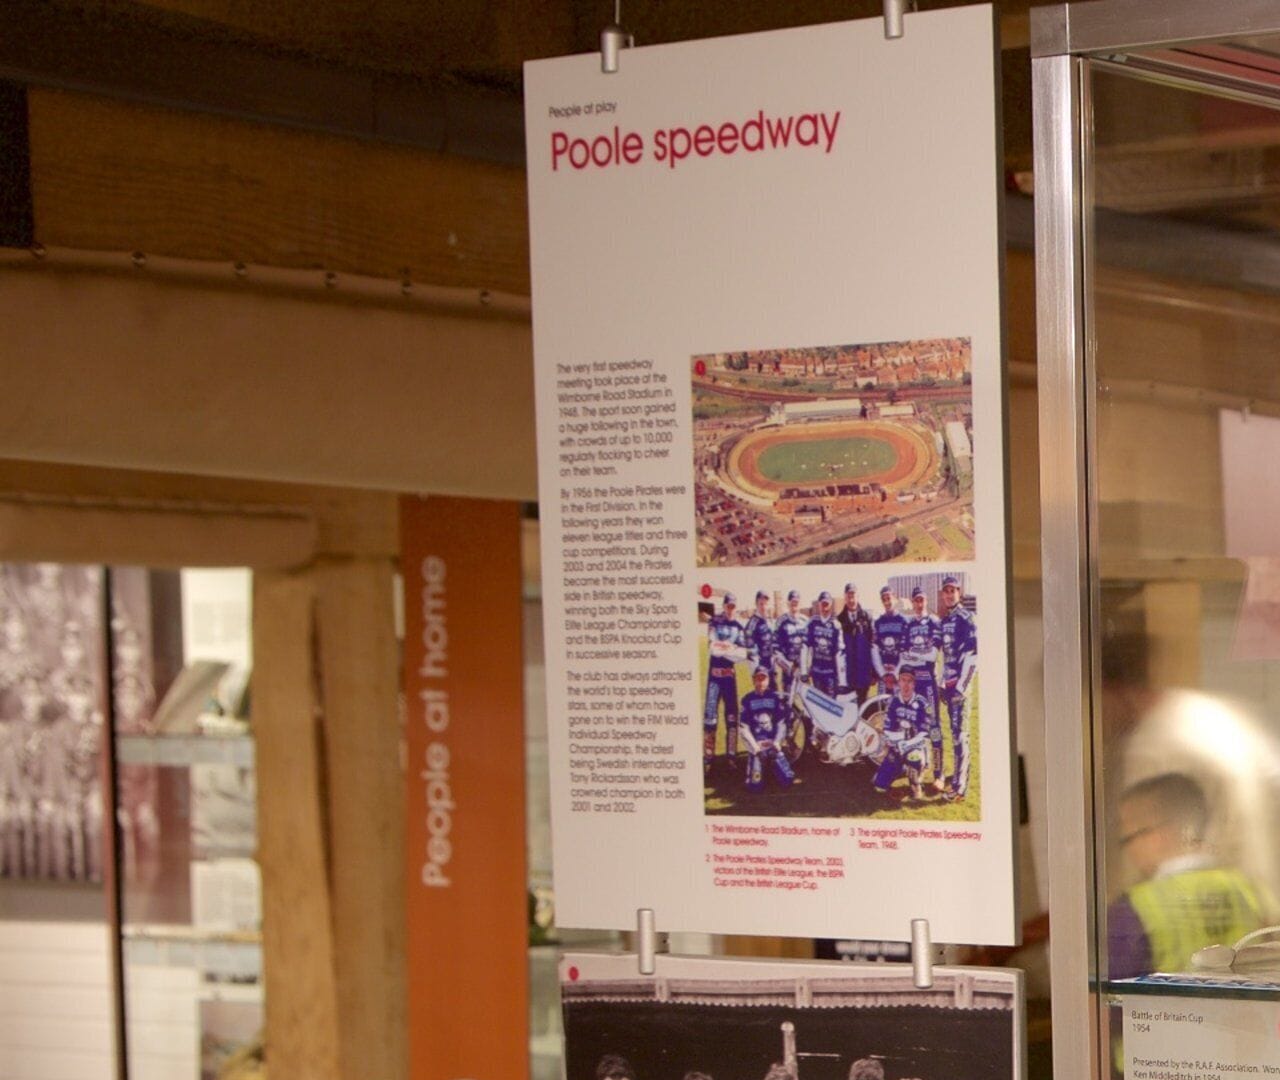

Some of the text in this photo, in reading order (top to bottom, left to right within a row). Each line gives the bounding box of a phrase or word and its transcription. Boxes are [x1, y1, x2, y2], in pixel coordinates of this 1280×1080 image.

[549, 101, 617, 118] People at play
[551, 110, 841, 171] Poole speedway
[608, 359, 653, 372] speedway
[420, 555, 457, 888] People at home
[1131, 1010, 1204, 1025] Battle of Britain Cup
[1131, 1023, 1151, 1034] 1954
